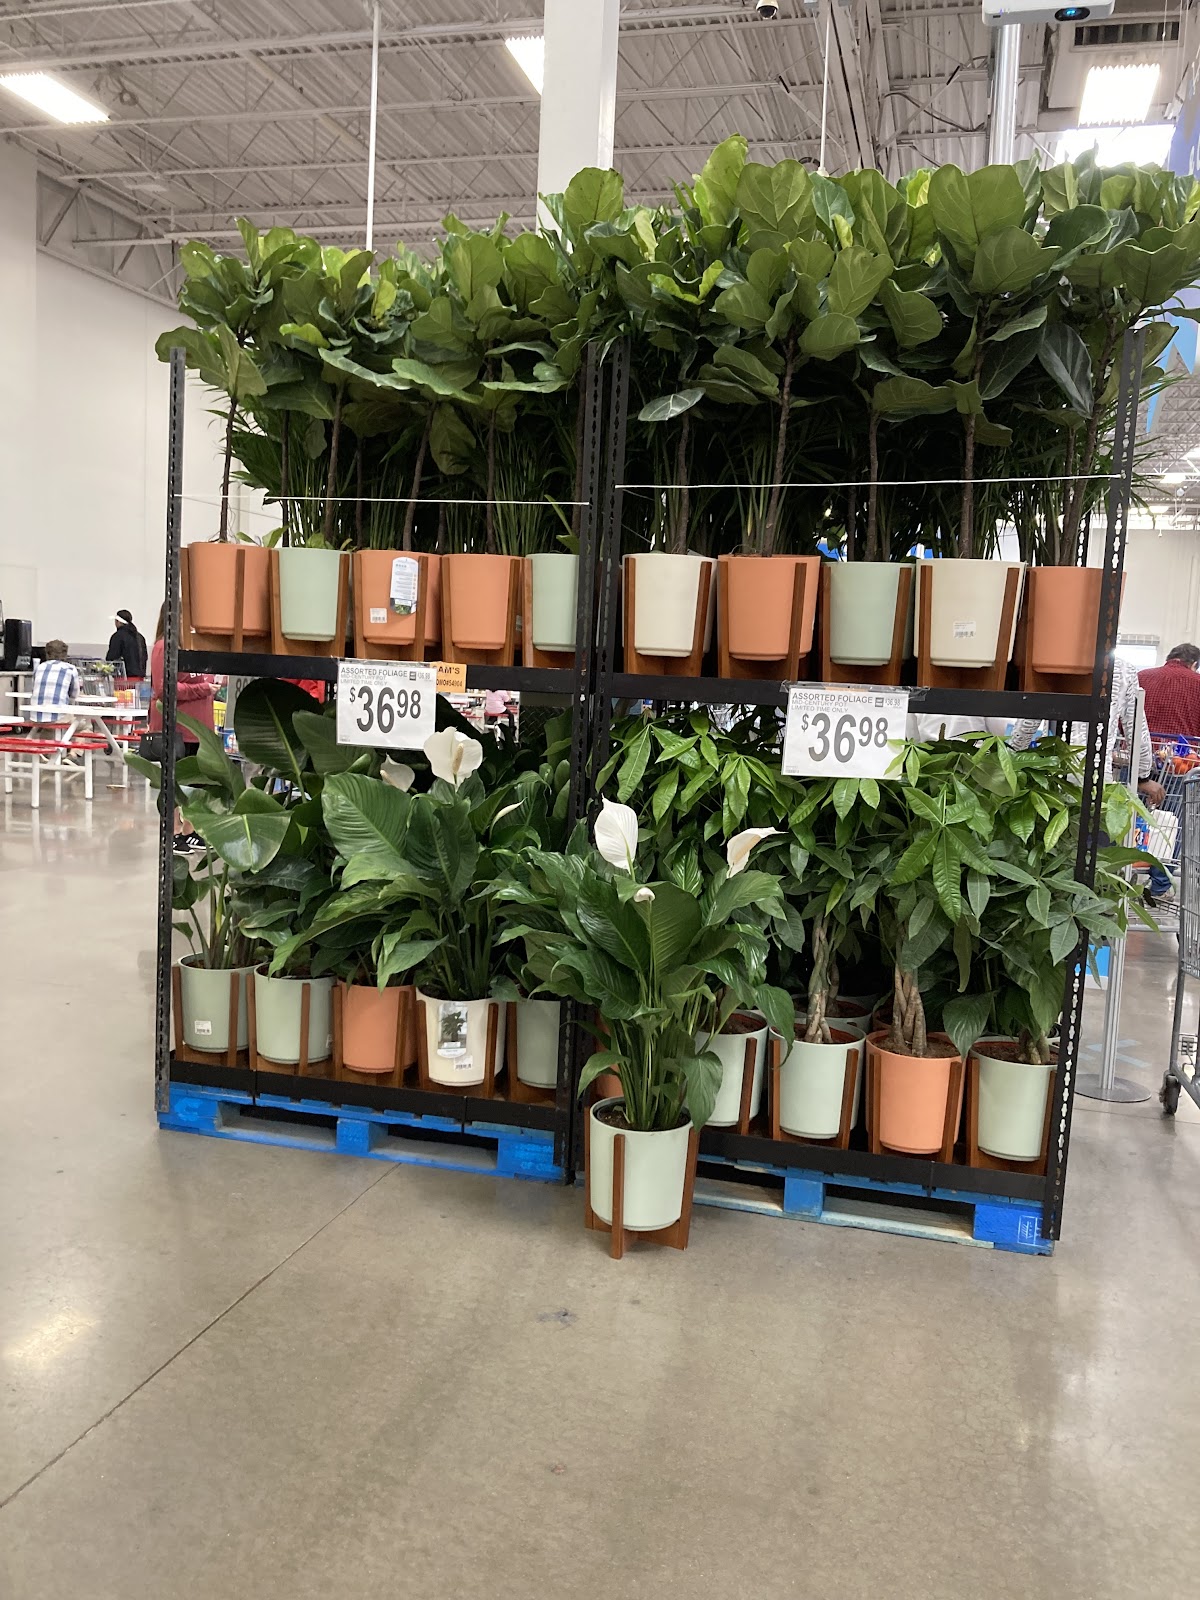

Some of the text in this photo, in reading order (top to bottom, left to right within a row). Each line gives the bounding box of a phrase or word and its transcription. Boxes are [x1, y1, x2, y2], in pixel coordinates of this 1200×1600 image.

[341, 667, 377, 676] ASSORTED
[433, 666, 460, 674] AM'S
[792, 692, 873, 703] ASSORTED FOLIAGE
